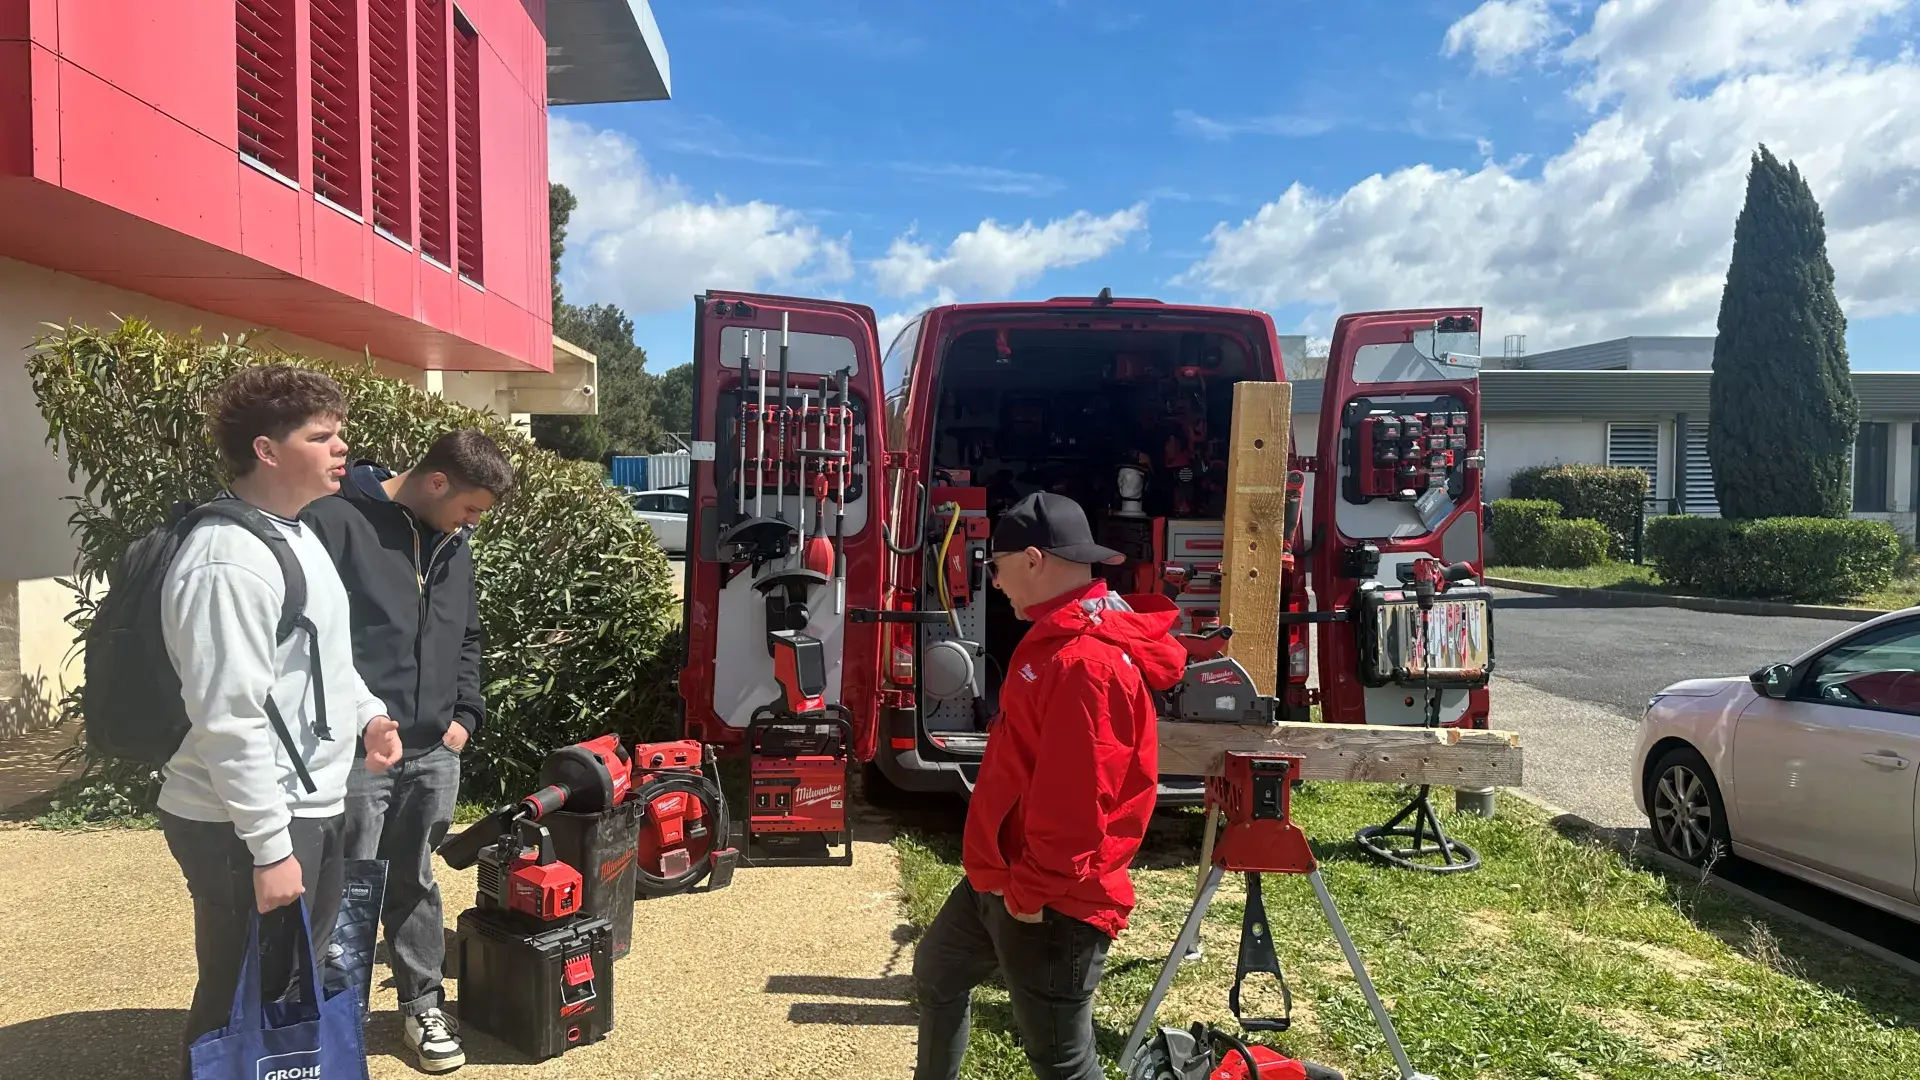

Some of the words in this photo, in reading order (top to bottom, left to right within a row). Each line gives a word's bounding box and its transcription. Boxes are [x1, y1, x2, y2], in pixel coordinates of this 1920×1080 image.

[1200, 670, 1233, 682] Milwaukee
[795, 784, 842, 803] Milwaukee
[600, 848, 635, 880] Milwaukee
